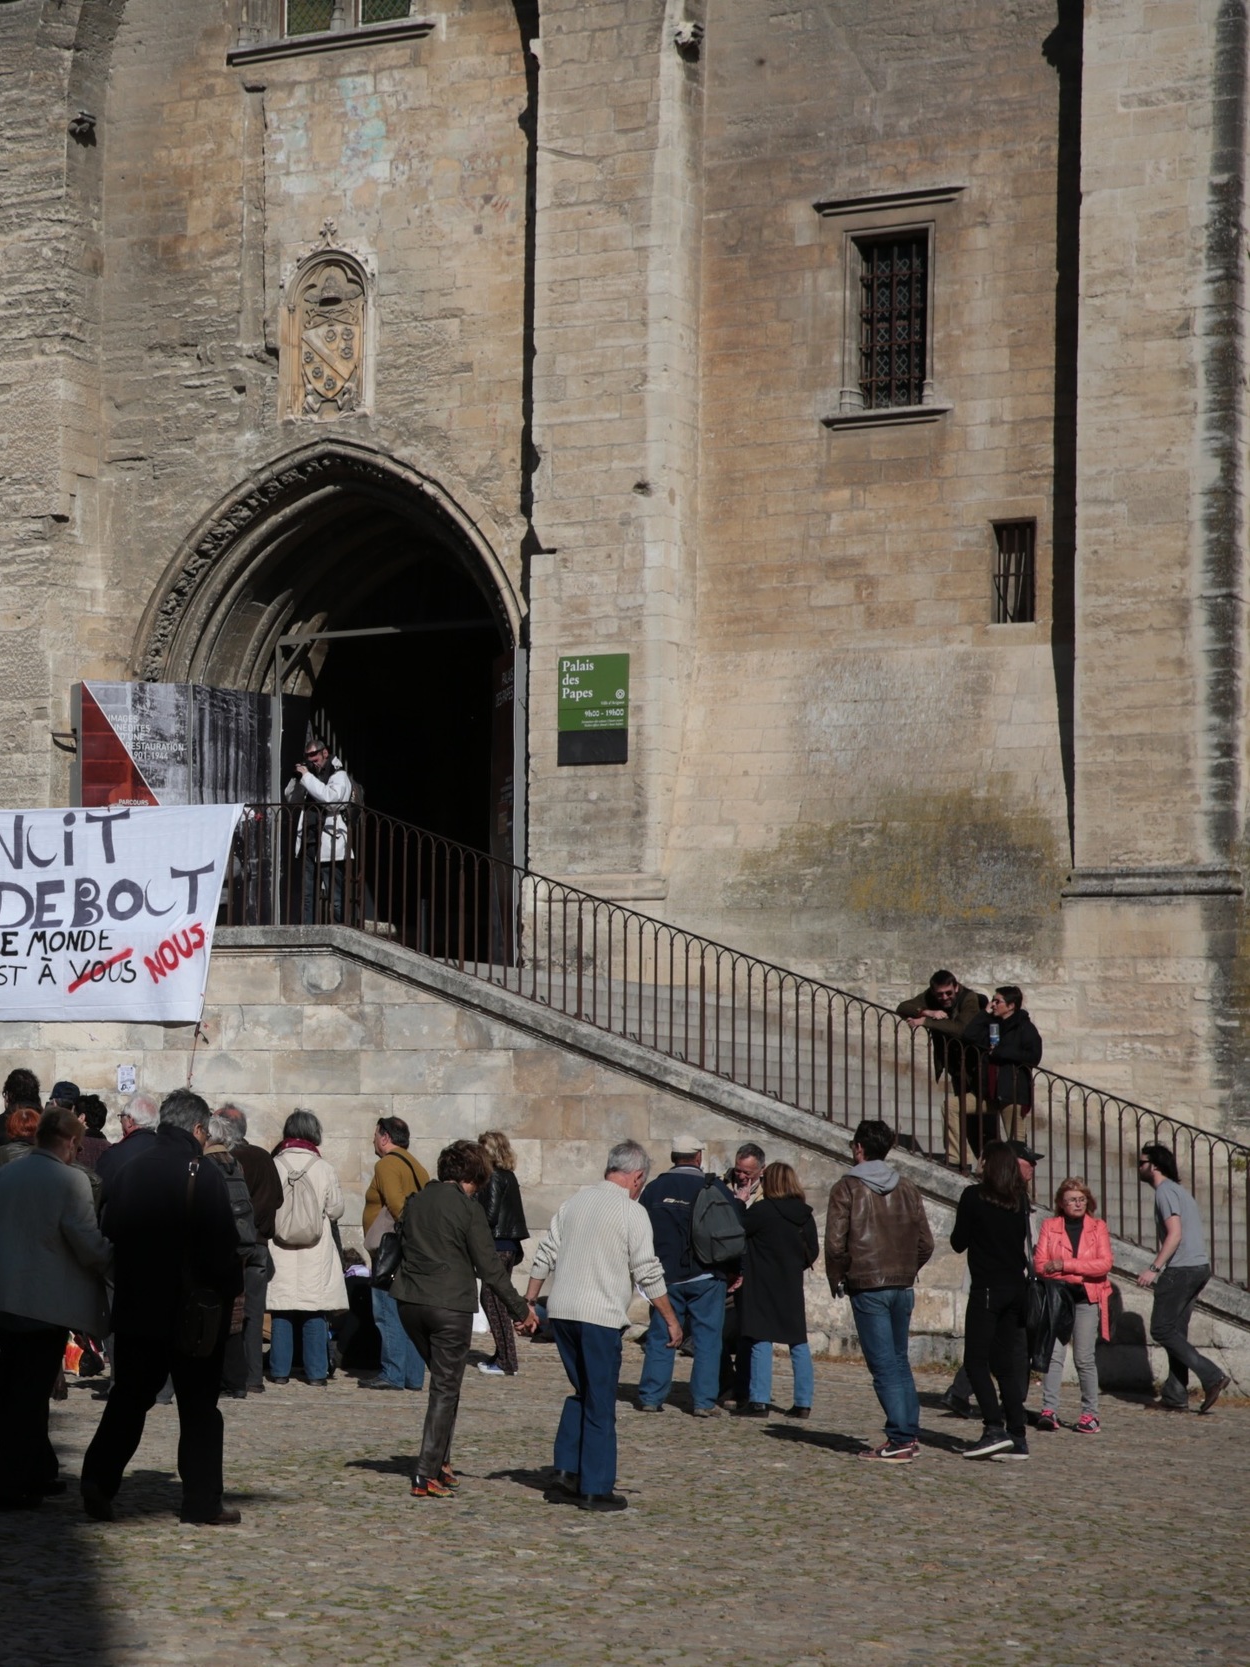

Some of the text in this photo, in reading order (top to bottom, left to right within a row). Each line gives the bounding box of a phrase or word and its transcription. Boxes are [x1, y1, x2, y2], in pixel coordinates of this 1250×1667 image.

[562, 660, 595, 672] Palais
[562, 673, 580, 685] des
[562, 687, 594, 701] Papes
[605, 708, 624, 716] 19h00
[108, 714, 139, 723] IMAGES
[125, 741, 184, 752] RESTAURATION
[118, 798, 149, 806] PARCOURS
[26, 928, 113, 956] MONDE
